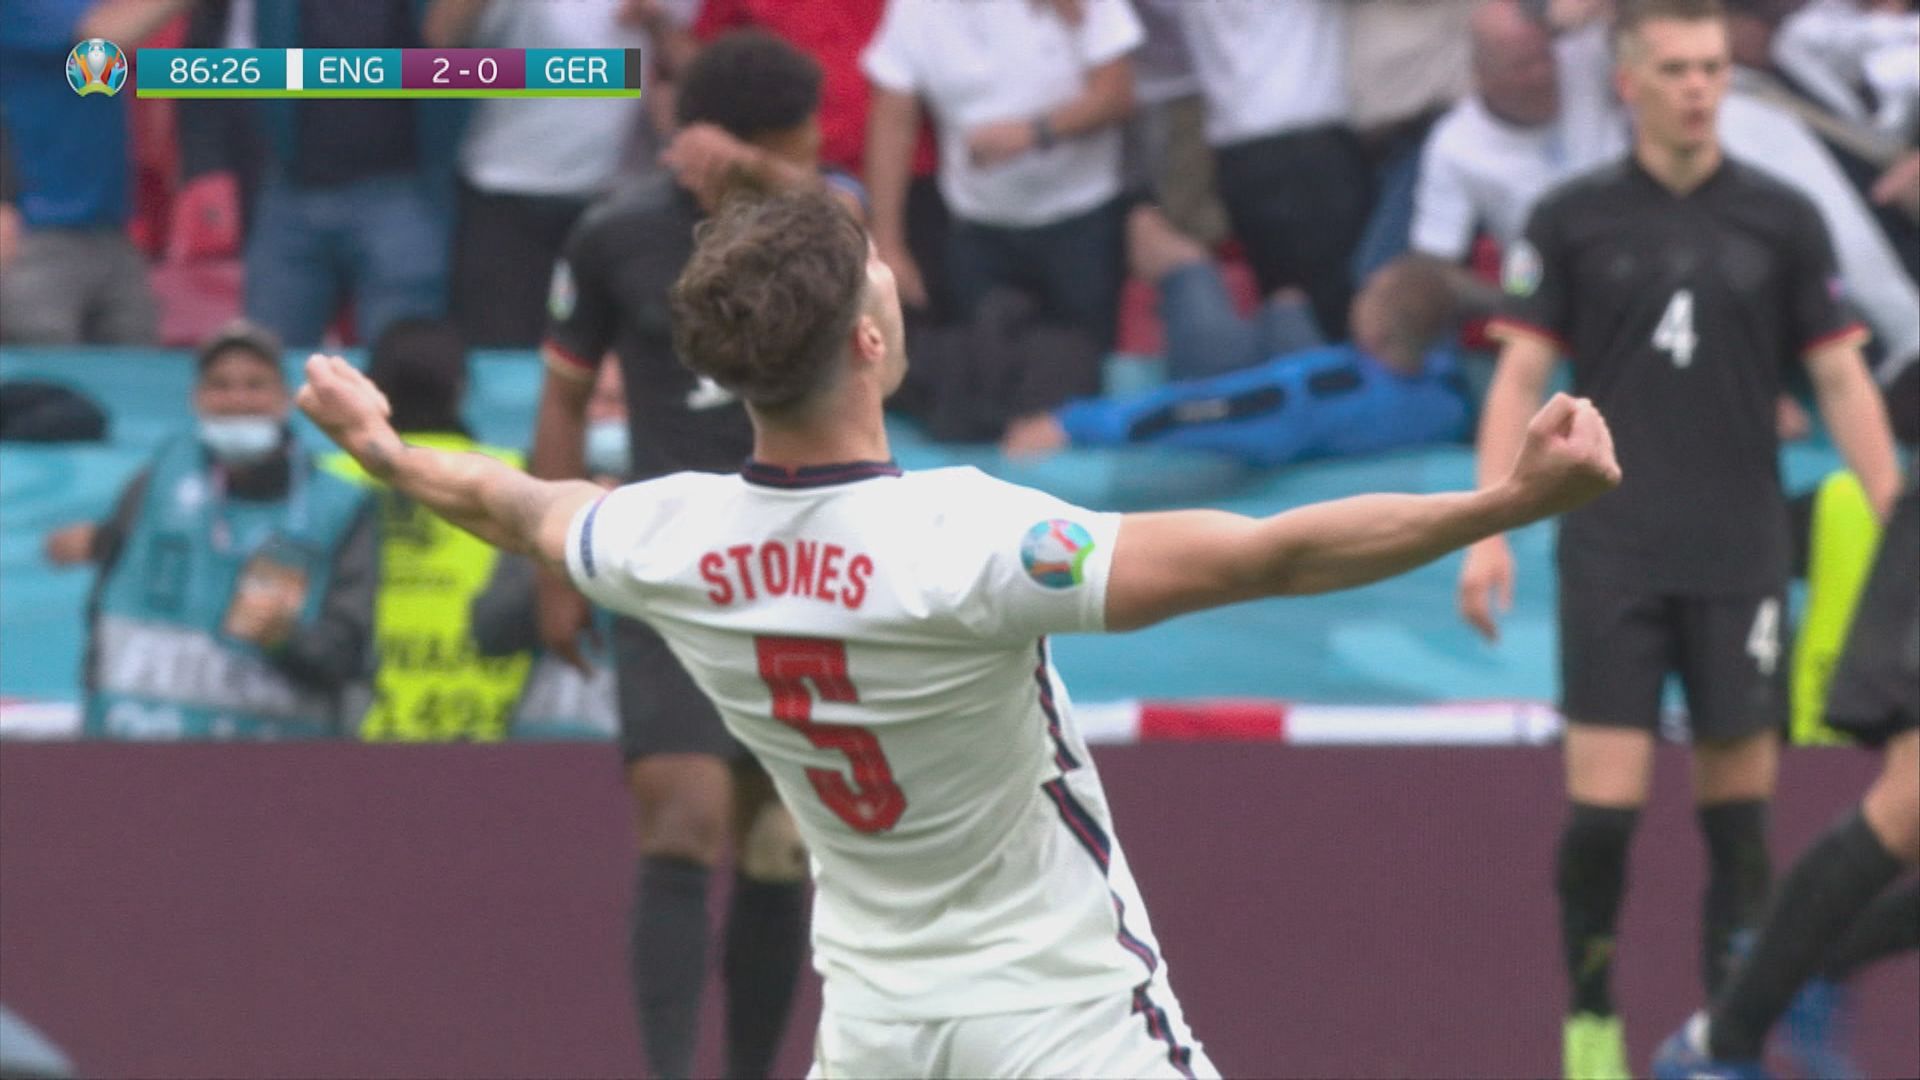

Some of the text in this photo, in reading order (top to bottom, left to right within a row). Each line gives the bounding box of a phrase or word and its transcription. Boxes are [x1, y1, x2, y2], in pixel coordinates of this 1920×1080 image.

[1651, 289, 1697, 367] 4
[699, 539, 874, 610] STONES
[1745, 599, 1782, 673] 4
[755, 636, 907, 834] 5
